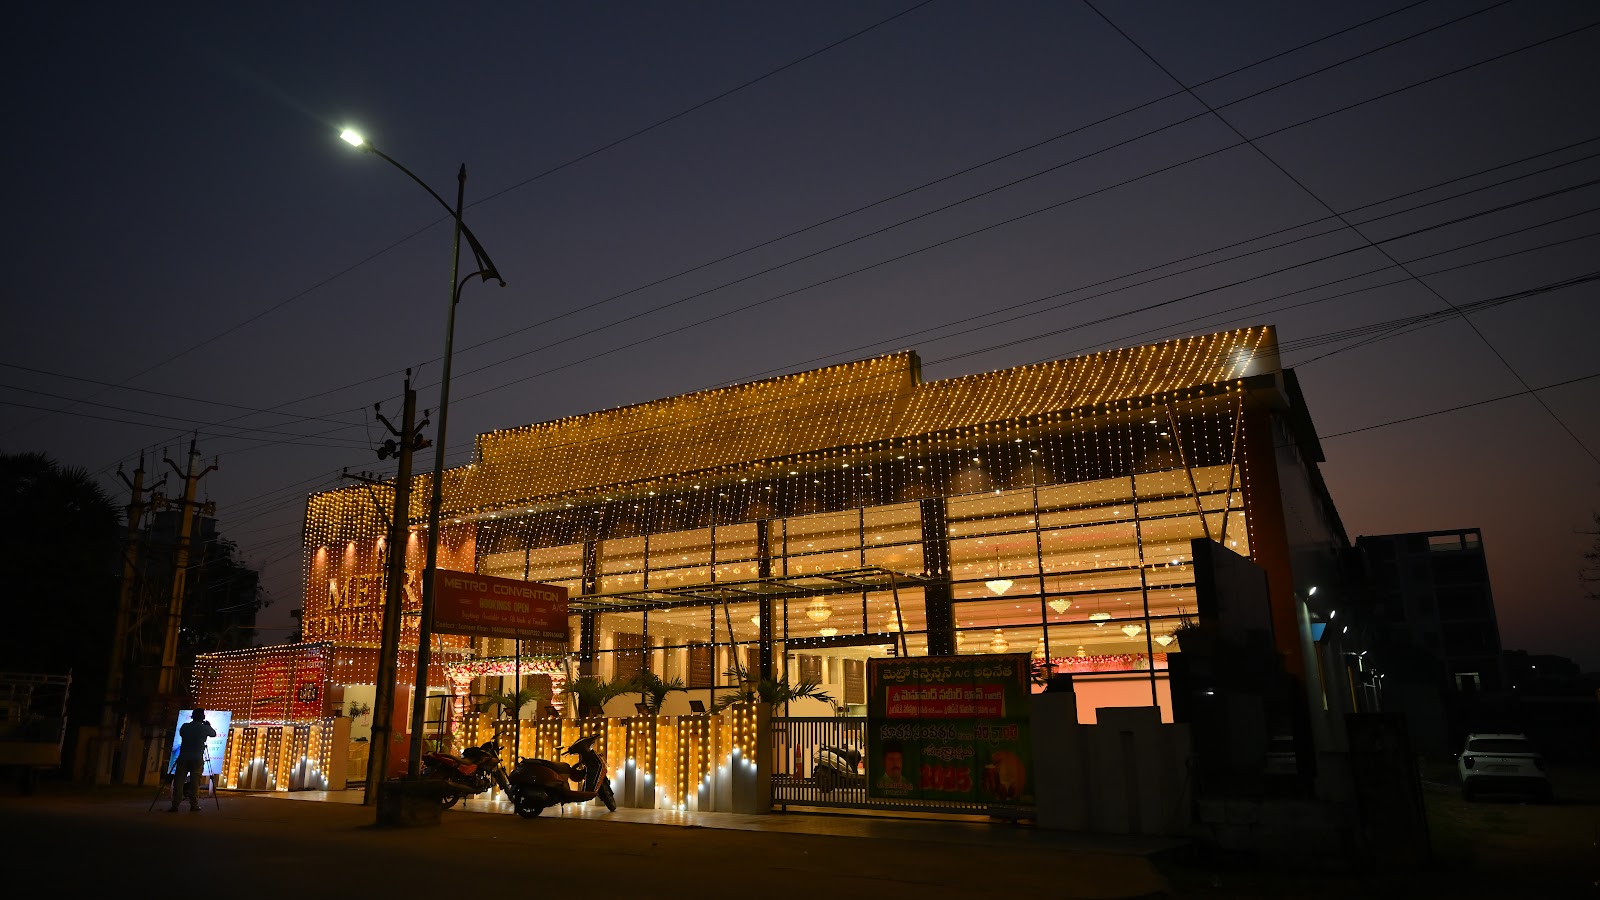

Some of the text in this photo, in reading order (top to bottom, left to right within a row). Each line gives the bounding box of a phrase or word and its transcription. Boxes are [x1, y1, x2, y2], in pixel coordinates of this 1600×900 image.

[444, 577, 559, 602] METRO CONVENTION
[479, 597, 530, 613] BOOKINGS OPEN
[552, 603, 564, 612] A/C
[954, 669, 970, 678] A/C
